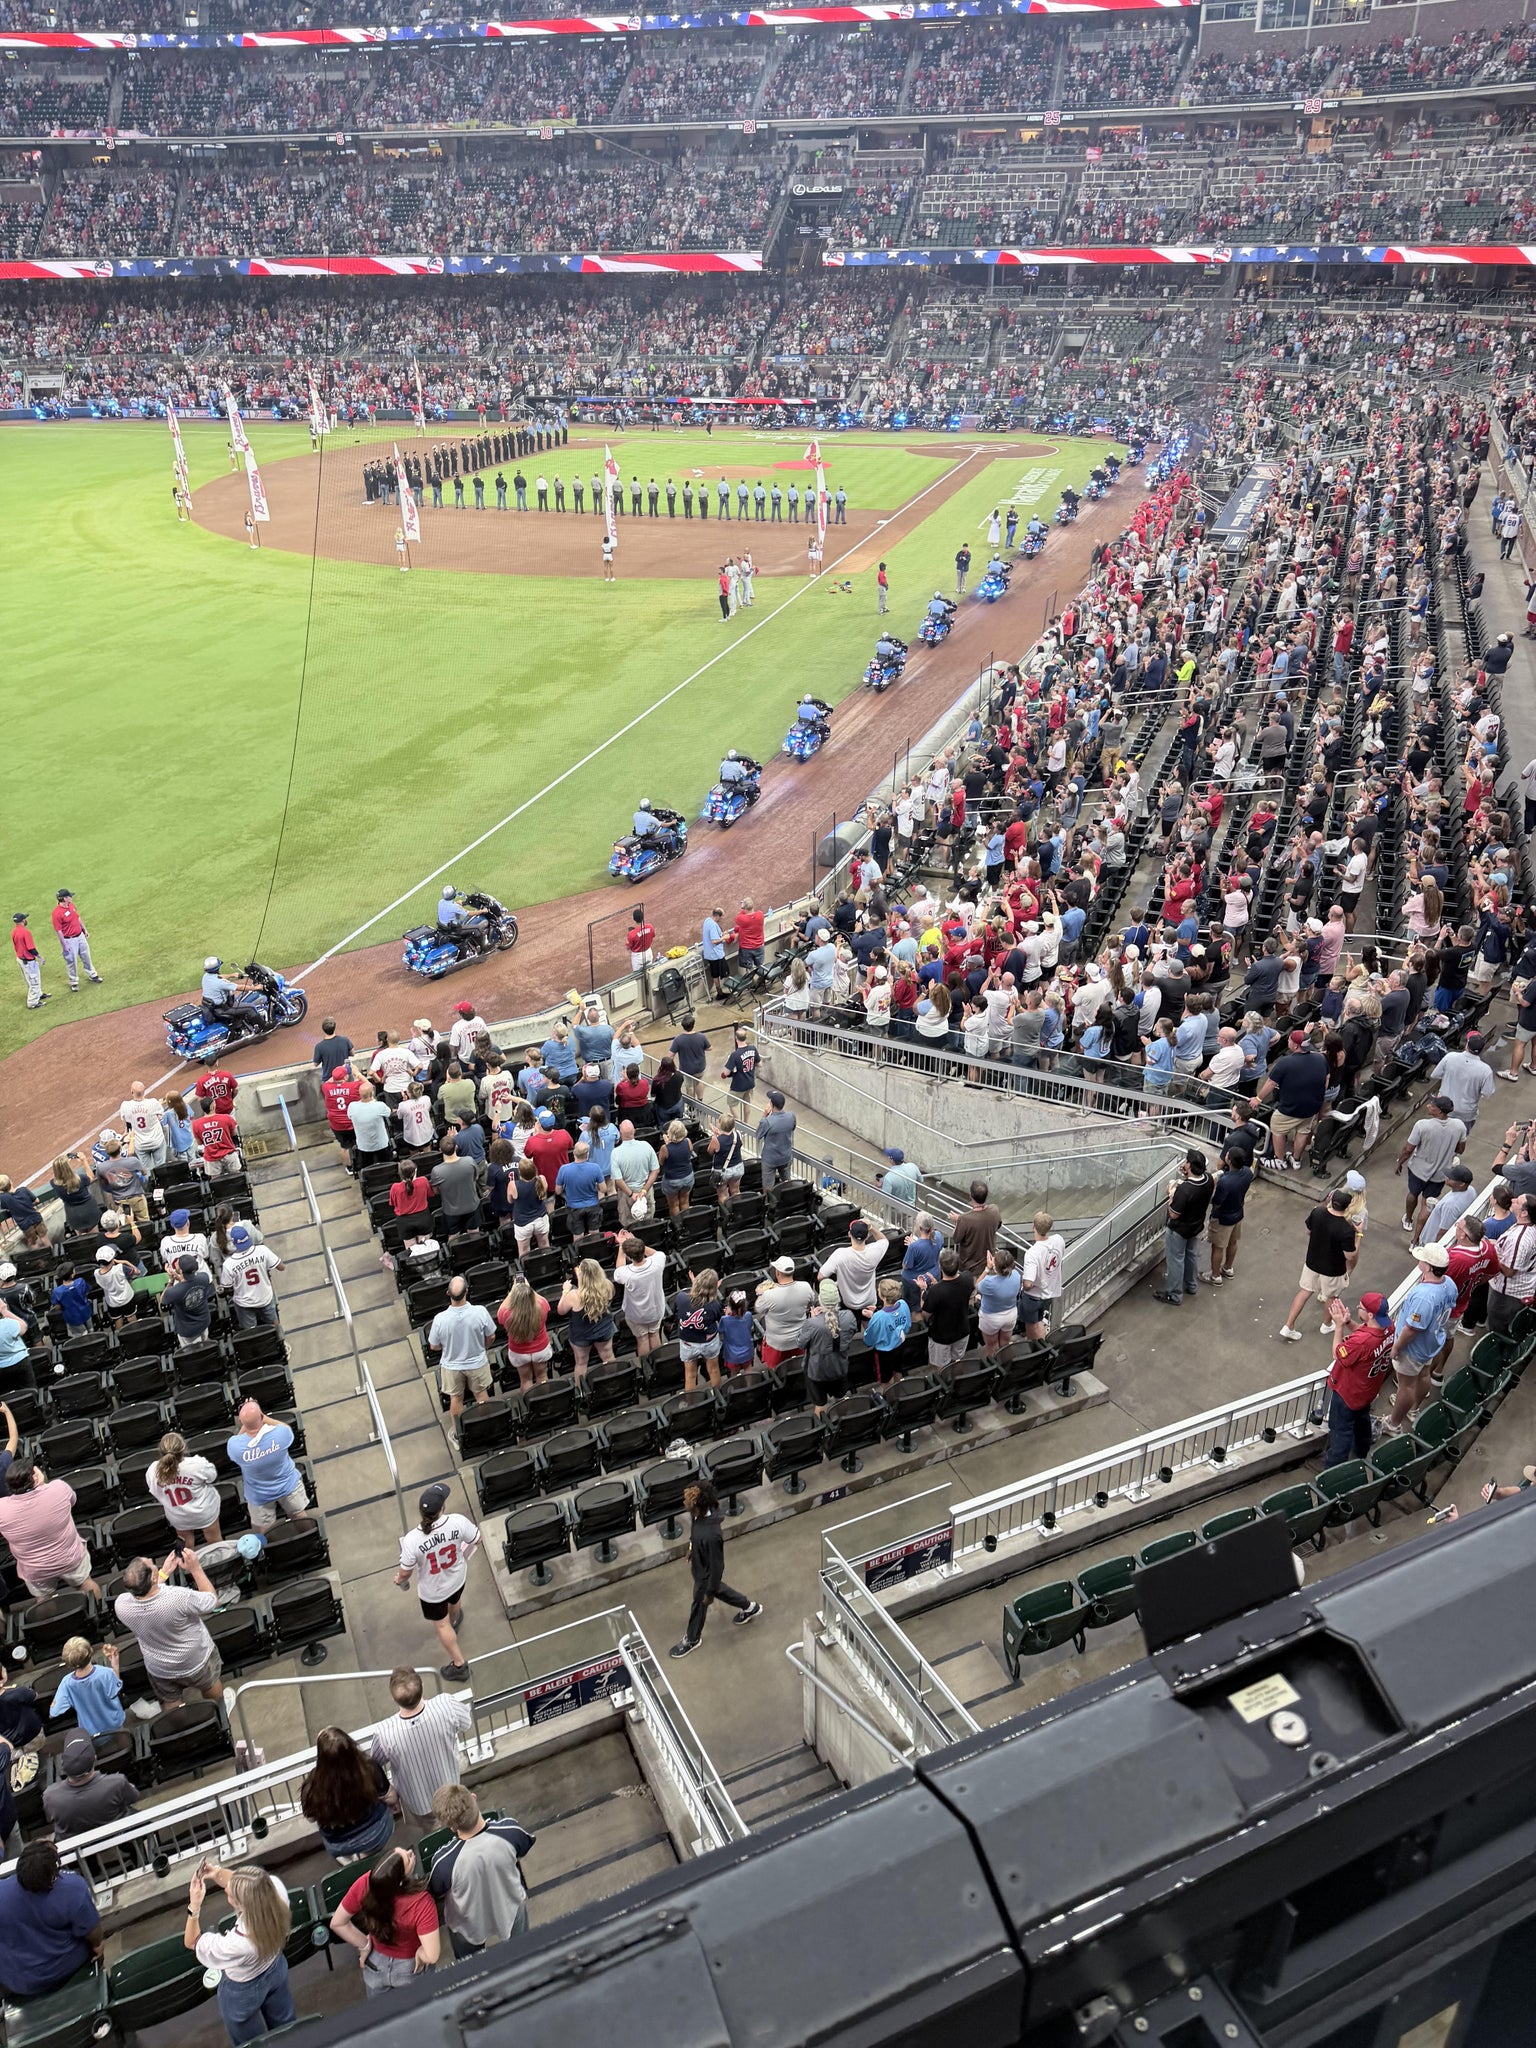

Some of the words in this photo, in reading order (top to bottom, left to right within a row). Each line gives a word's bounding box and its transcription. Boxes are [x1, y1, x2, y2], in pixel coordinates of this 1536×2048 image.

[1304, 98, 1321, 114] 29
[1044, 111, 1061, 125] 25
[540, 126, 553, 140] 10
[743, 120, 756, 134] 21
[105, 137, 115, 149] 3
[336, 132, 344, 145] 6
[250, 474, 266, 515] Braves
[967, 914, 973, 926] 3
[743, 1057, 755, 1073] 31
[209, 1084, 227, 1100] 13
[329, 1088, 350, 1097] HARPER
[336, 1097, 346, 1110] 3
[136, 1117, 146, 1128] 3
[203, 1121, 219, 1129] RILEY
[415, 1111, 422, 1124] 3
[202, 1129, 222, 1146] 27
[232, 1255, 265, 1275] FREEMAN
[244, 1268, 260, 1286] 5
[680, 1308, 704, 1329] A
[243, 1440, 280, 1462] Atlanta
[164, 1487, 193, 1507] 10
[830, 1489, 840, 1498] 41
[418, 1532, 446, 1554] ACUÑA
[447, 1529, 460, 1541] JR
[913, 1531, 950, 1550] CAUTION
[426, 1543, 457, 1575] 13
[869, 1559, 881, 1568] BE
[882, 1547, 906, 1562] ALERT
[920, 1557, 940, 1568] WATCH
[915, 1566, 931, 1574] YOUR
[931, 1559, 946, 1568] STEP
[529, 1687, 542, 1698] BE
[545, 1675, 574, 1692] ALERT
[589, 1692, 608, 1702] YOUR
[609, 1685, 626, 1697] STEP
[595, 1683, 619, 1695] WATCH
